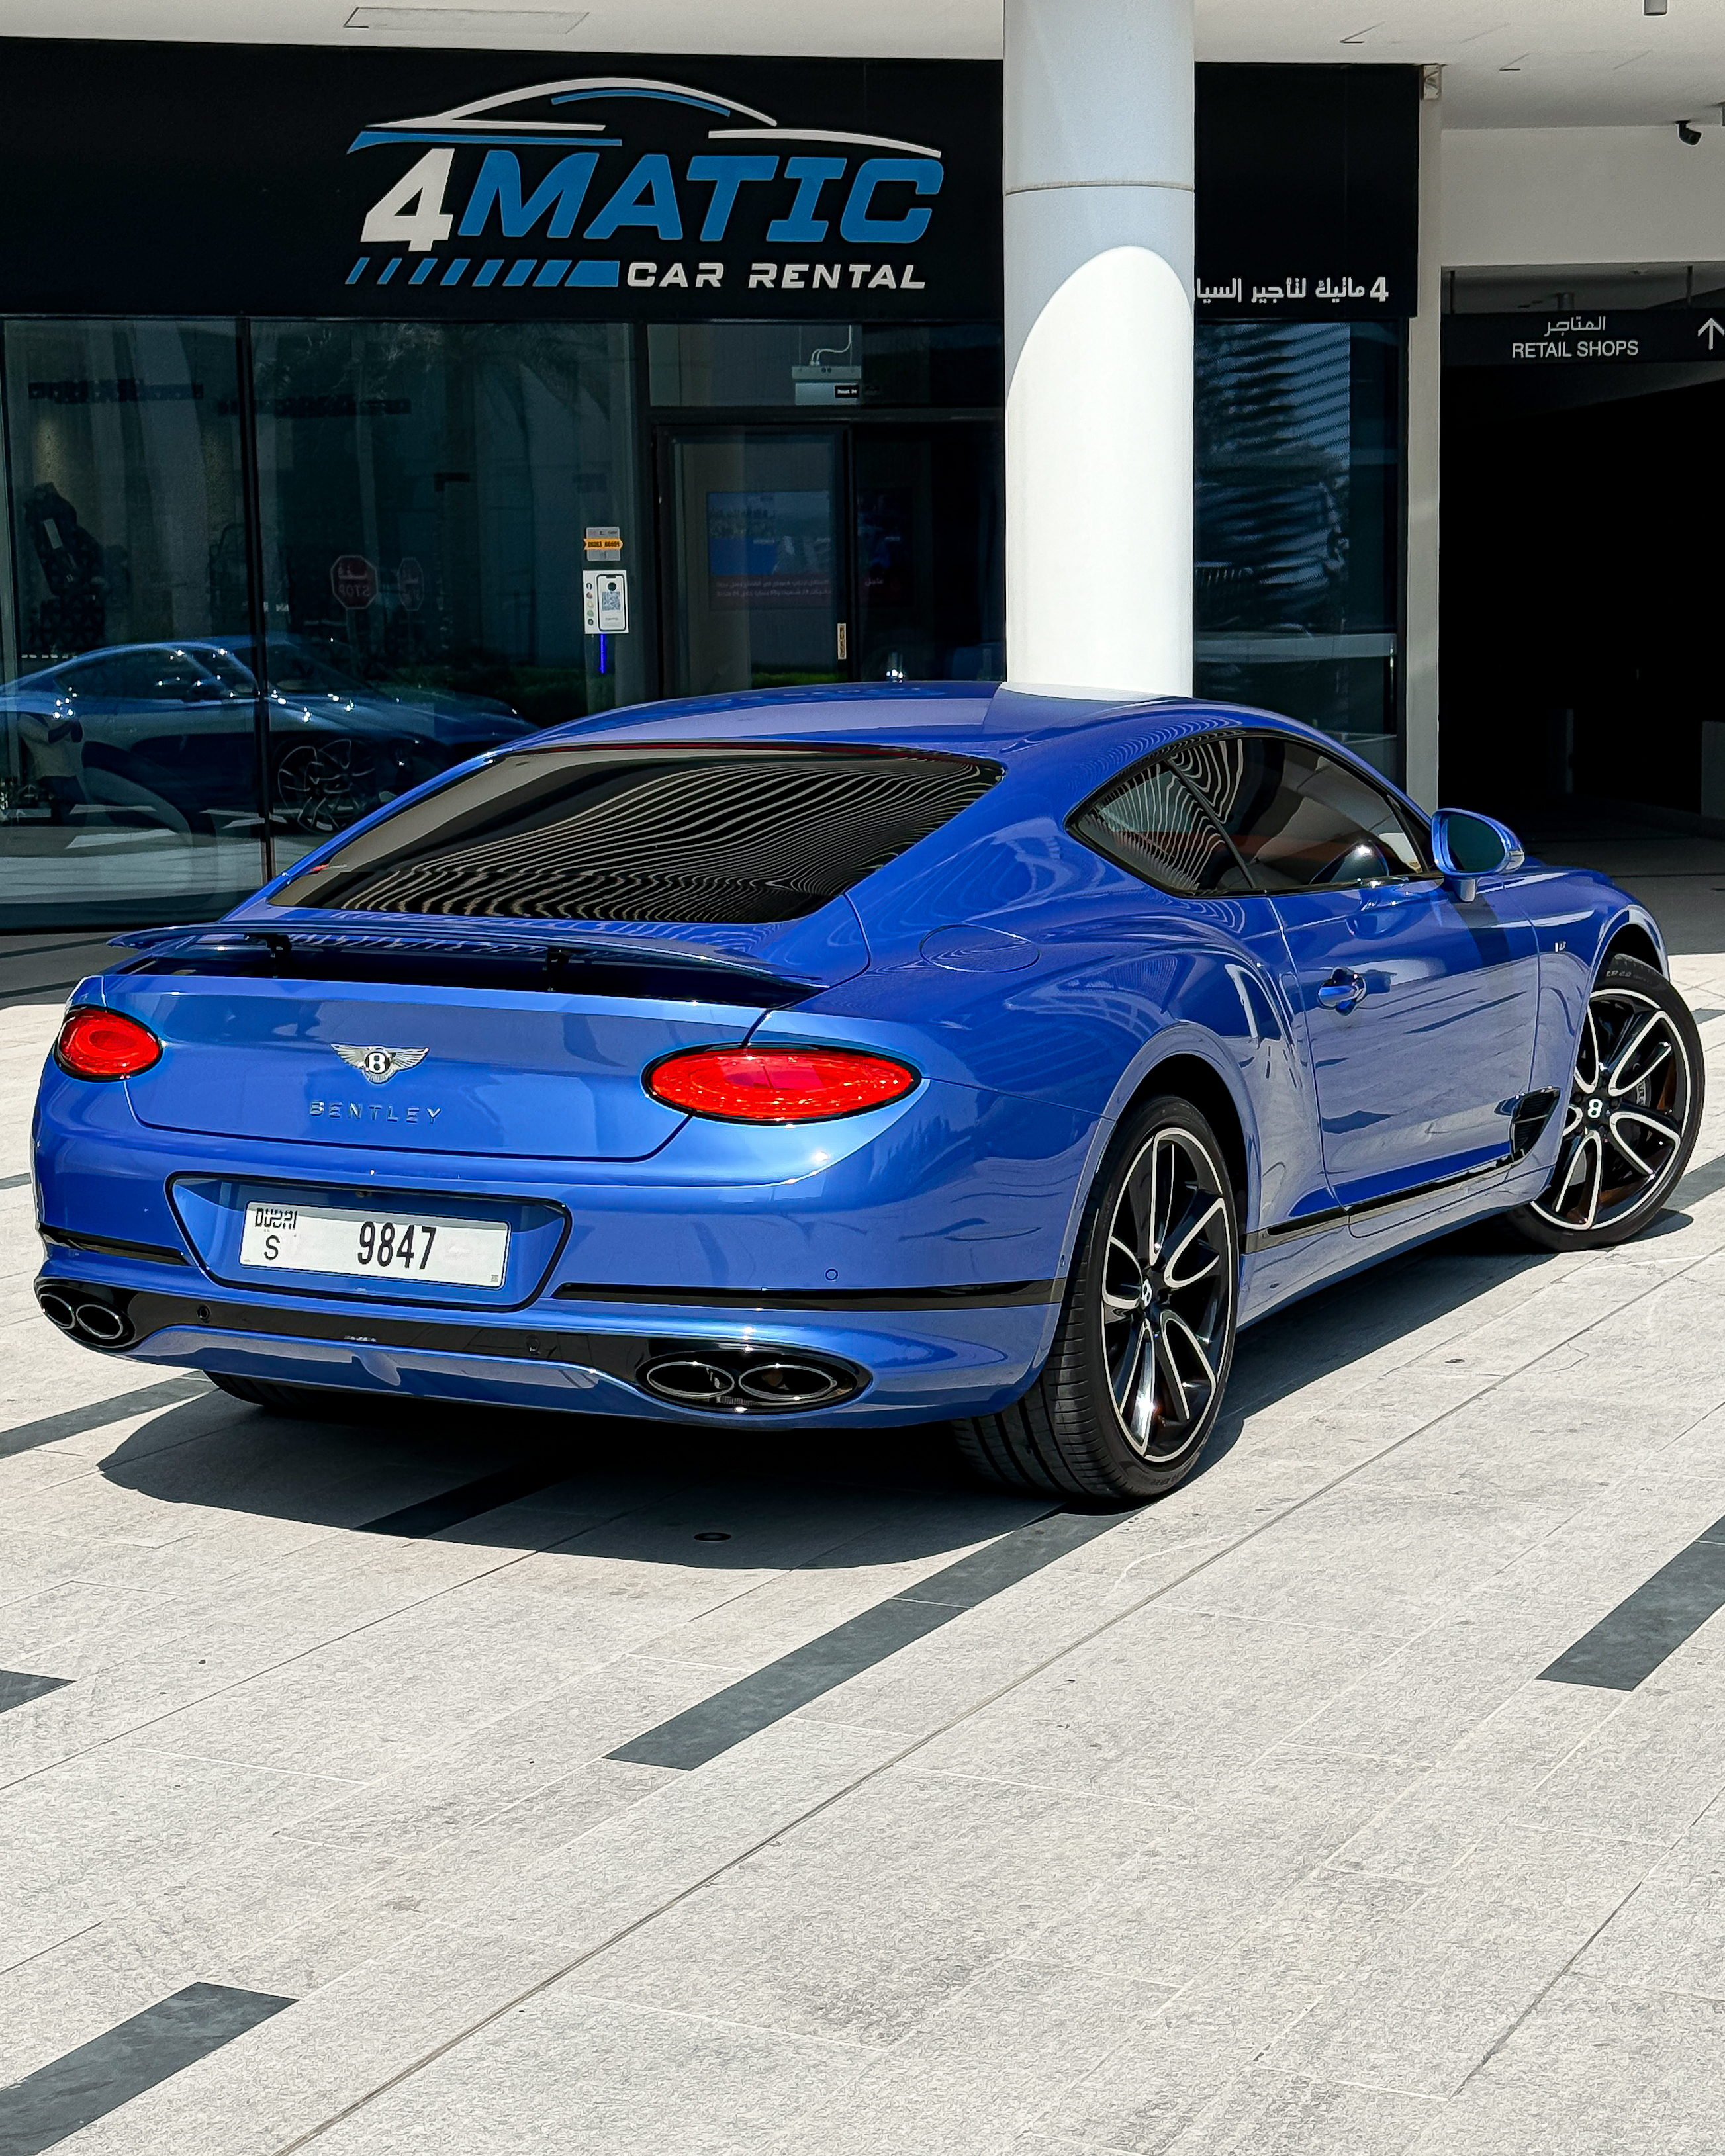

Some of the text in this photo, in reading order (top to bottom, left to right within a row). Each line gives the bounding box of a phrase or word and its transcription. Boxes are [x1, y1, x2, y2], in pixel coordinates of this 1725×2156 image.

[360, 148, 945, 251] 4MATIC
[626, 261, 927, 290] CAR RENTAL
[1195, 276, 1389, 304] 4 ماتيك لتأجير السيا
[1543, 316, 1607, 337] المتاجر
[1511, 339, 1639, 359] RETAIL SHOPS
[309, 1100, 442, 1125] BENTLEY
[263, 1235, 281, 1261] S
[357, 1220, 437, 1271] 9847
